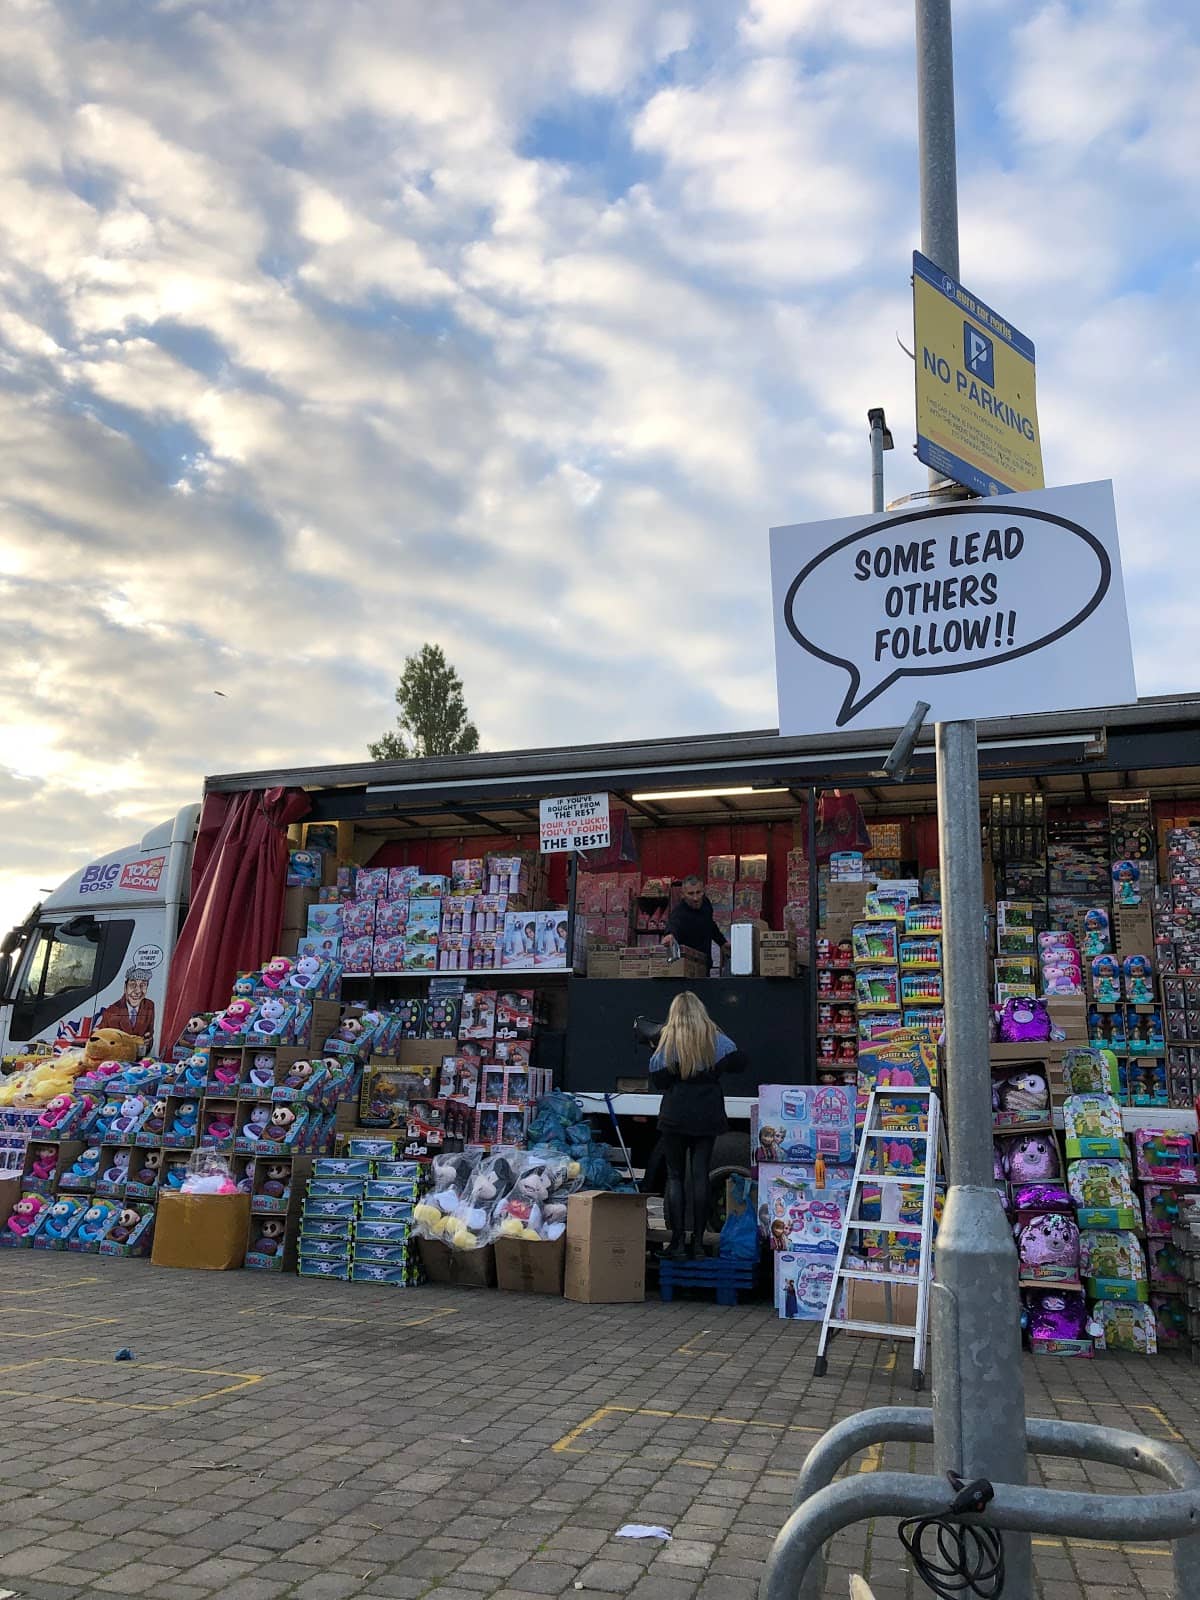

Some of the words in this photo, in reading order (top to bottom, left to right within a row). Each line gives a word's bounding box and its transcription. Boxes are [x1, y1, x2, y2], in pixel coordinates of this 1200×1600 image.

[924, 346, 950, 384] NO
[957, 369, 1035, 442] PARKING
[854, 538, 937, 581] SOME
[949, 527, 1024, 567] LEAD
[885, 572, 998, 617] OTHERS
[874, 610, 1017, 661] FOLLOW!!
[548, 804, 577, 813] BOUGHT
[580, 801, 600, 809] FROM
[567, 796, 592, 804] YOU'VE
[554, 811, 571, 819] THE
[575, 808, 596, 817] REST
[541, 822, 563, 830] YOUR
[580, 816, 608, 826] LUCKY!
[541, 828, 573, 837] YOU'VE
[577, 824, 608, 833] FOUND
[542, 838, 567, 850] THE
[574, 833, 608, 847] BEST!
[81, 864, 120, 883] BIG
[80, 881, 114, 894] BOSS
[122, 877, 158, 888] AUCTION
